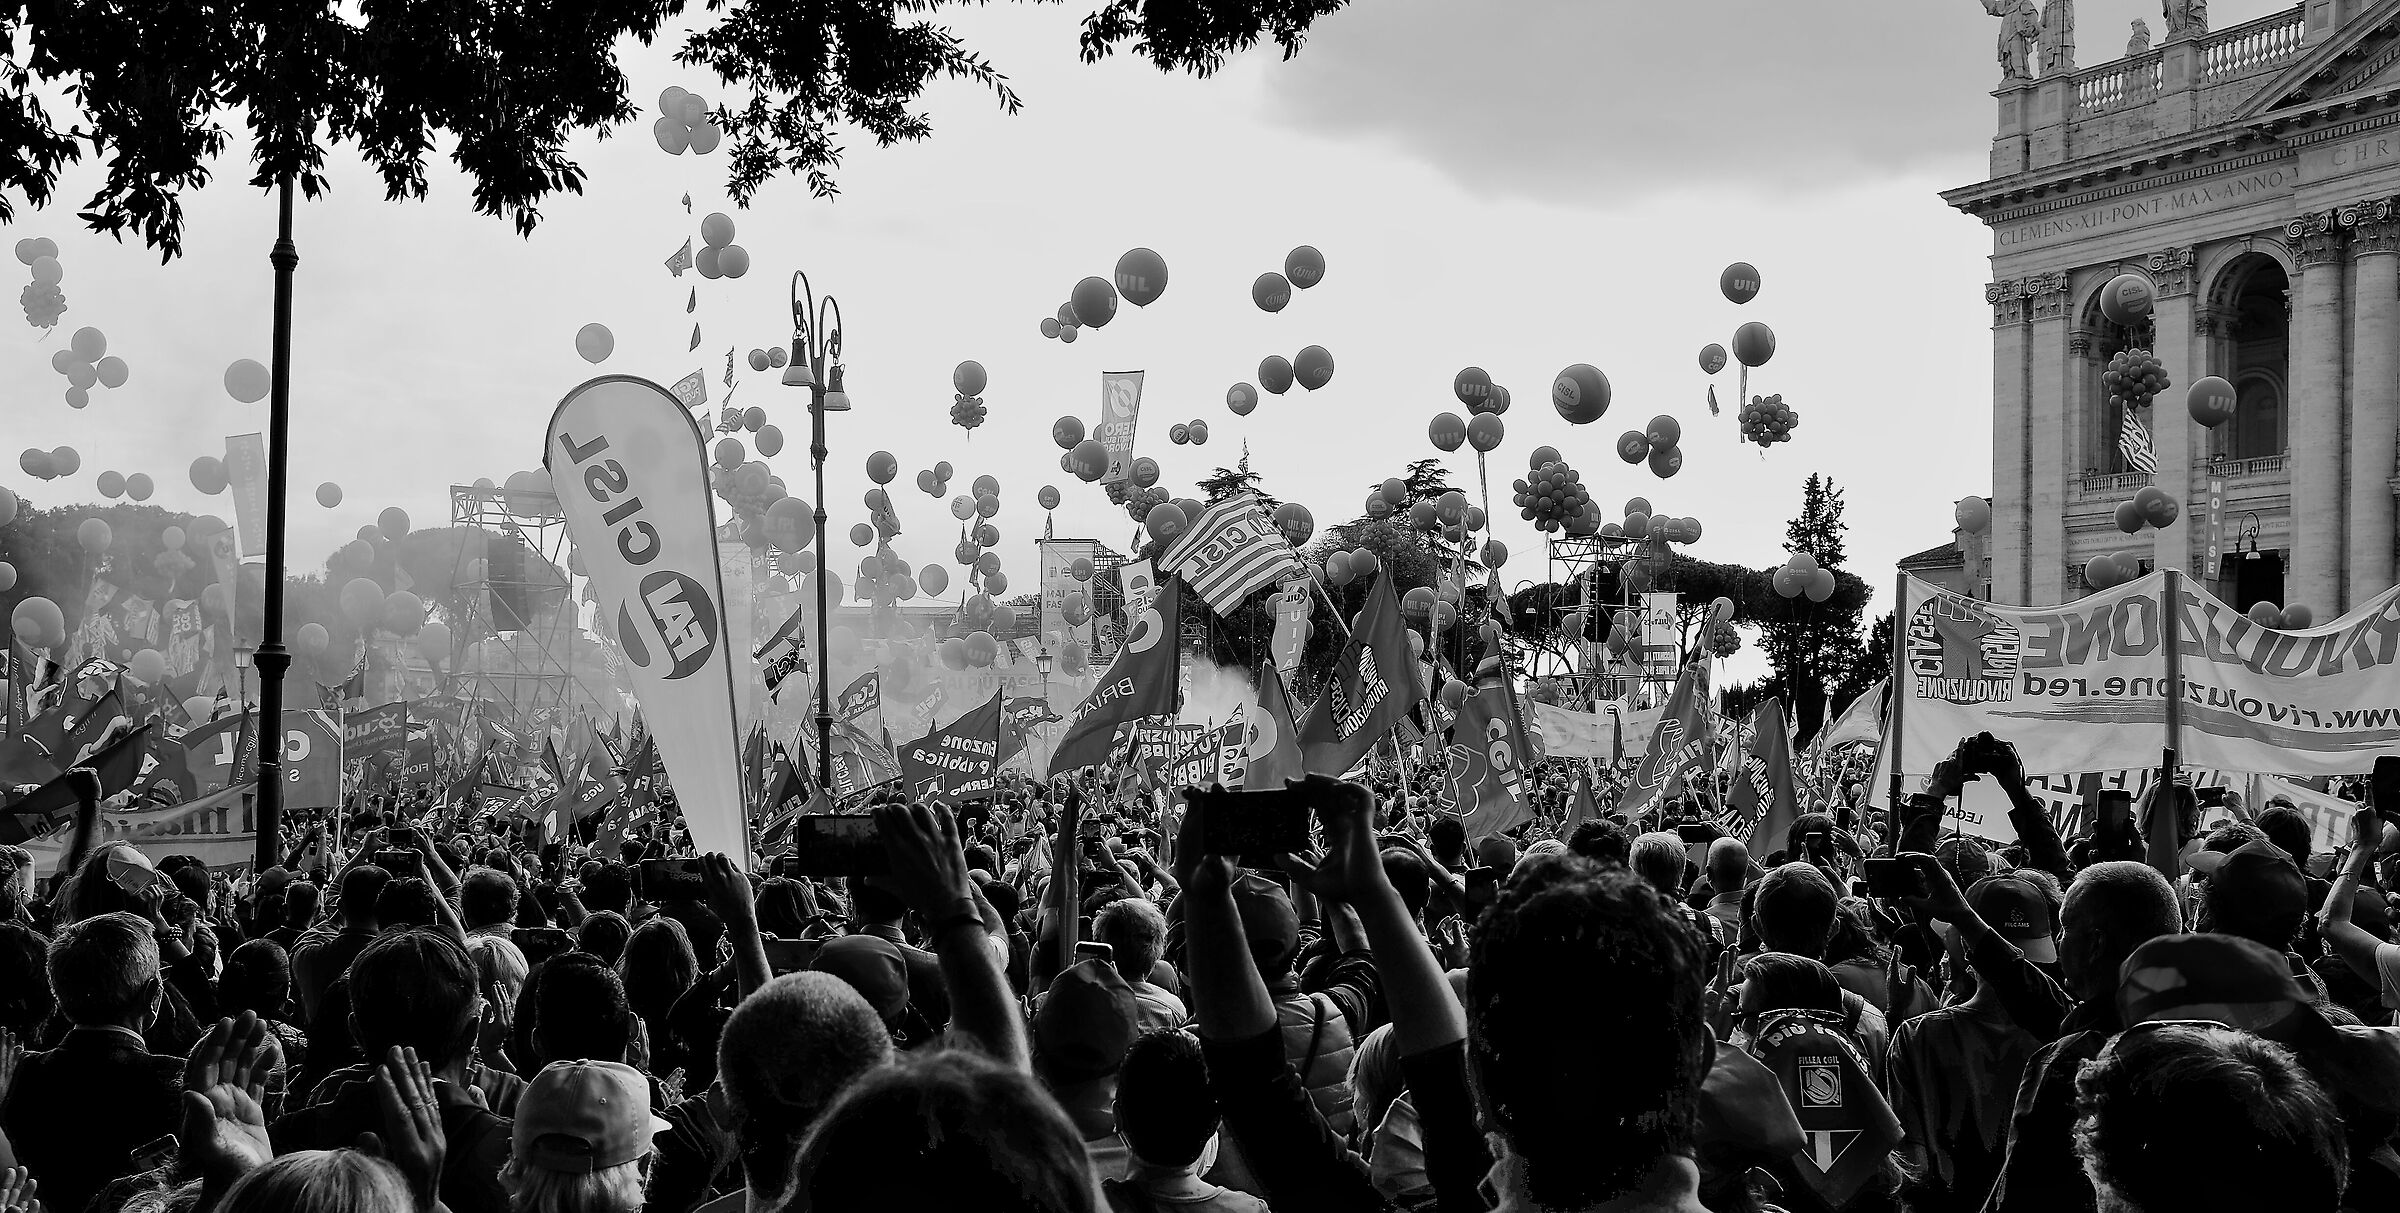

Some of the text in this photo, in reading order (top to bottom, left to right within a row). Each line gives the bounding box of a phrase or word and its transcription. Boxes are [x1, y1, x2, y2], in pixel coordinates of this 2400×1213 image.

[2000, 170, 2284, 247] CLEMENS XII PONT MAX ANNO
[1118, 272, 1149, 292] UIL
[1734, 279, 1757, 291] UIL
[2122, 286, 2143, 297] CISL
[1461, 383, 1487, 396] UIL
[1557, 383, 1575, 400] CISL
[1070, 458, 1093, 475] UIL
[1287, 519, 1299, 530] UIL
[2207, 481, 2221, 574] MOLISE
[1407, 601, 1419, 610] UIL
[1799, 1055, 1840, 1064] FILLEA CGIL
